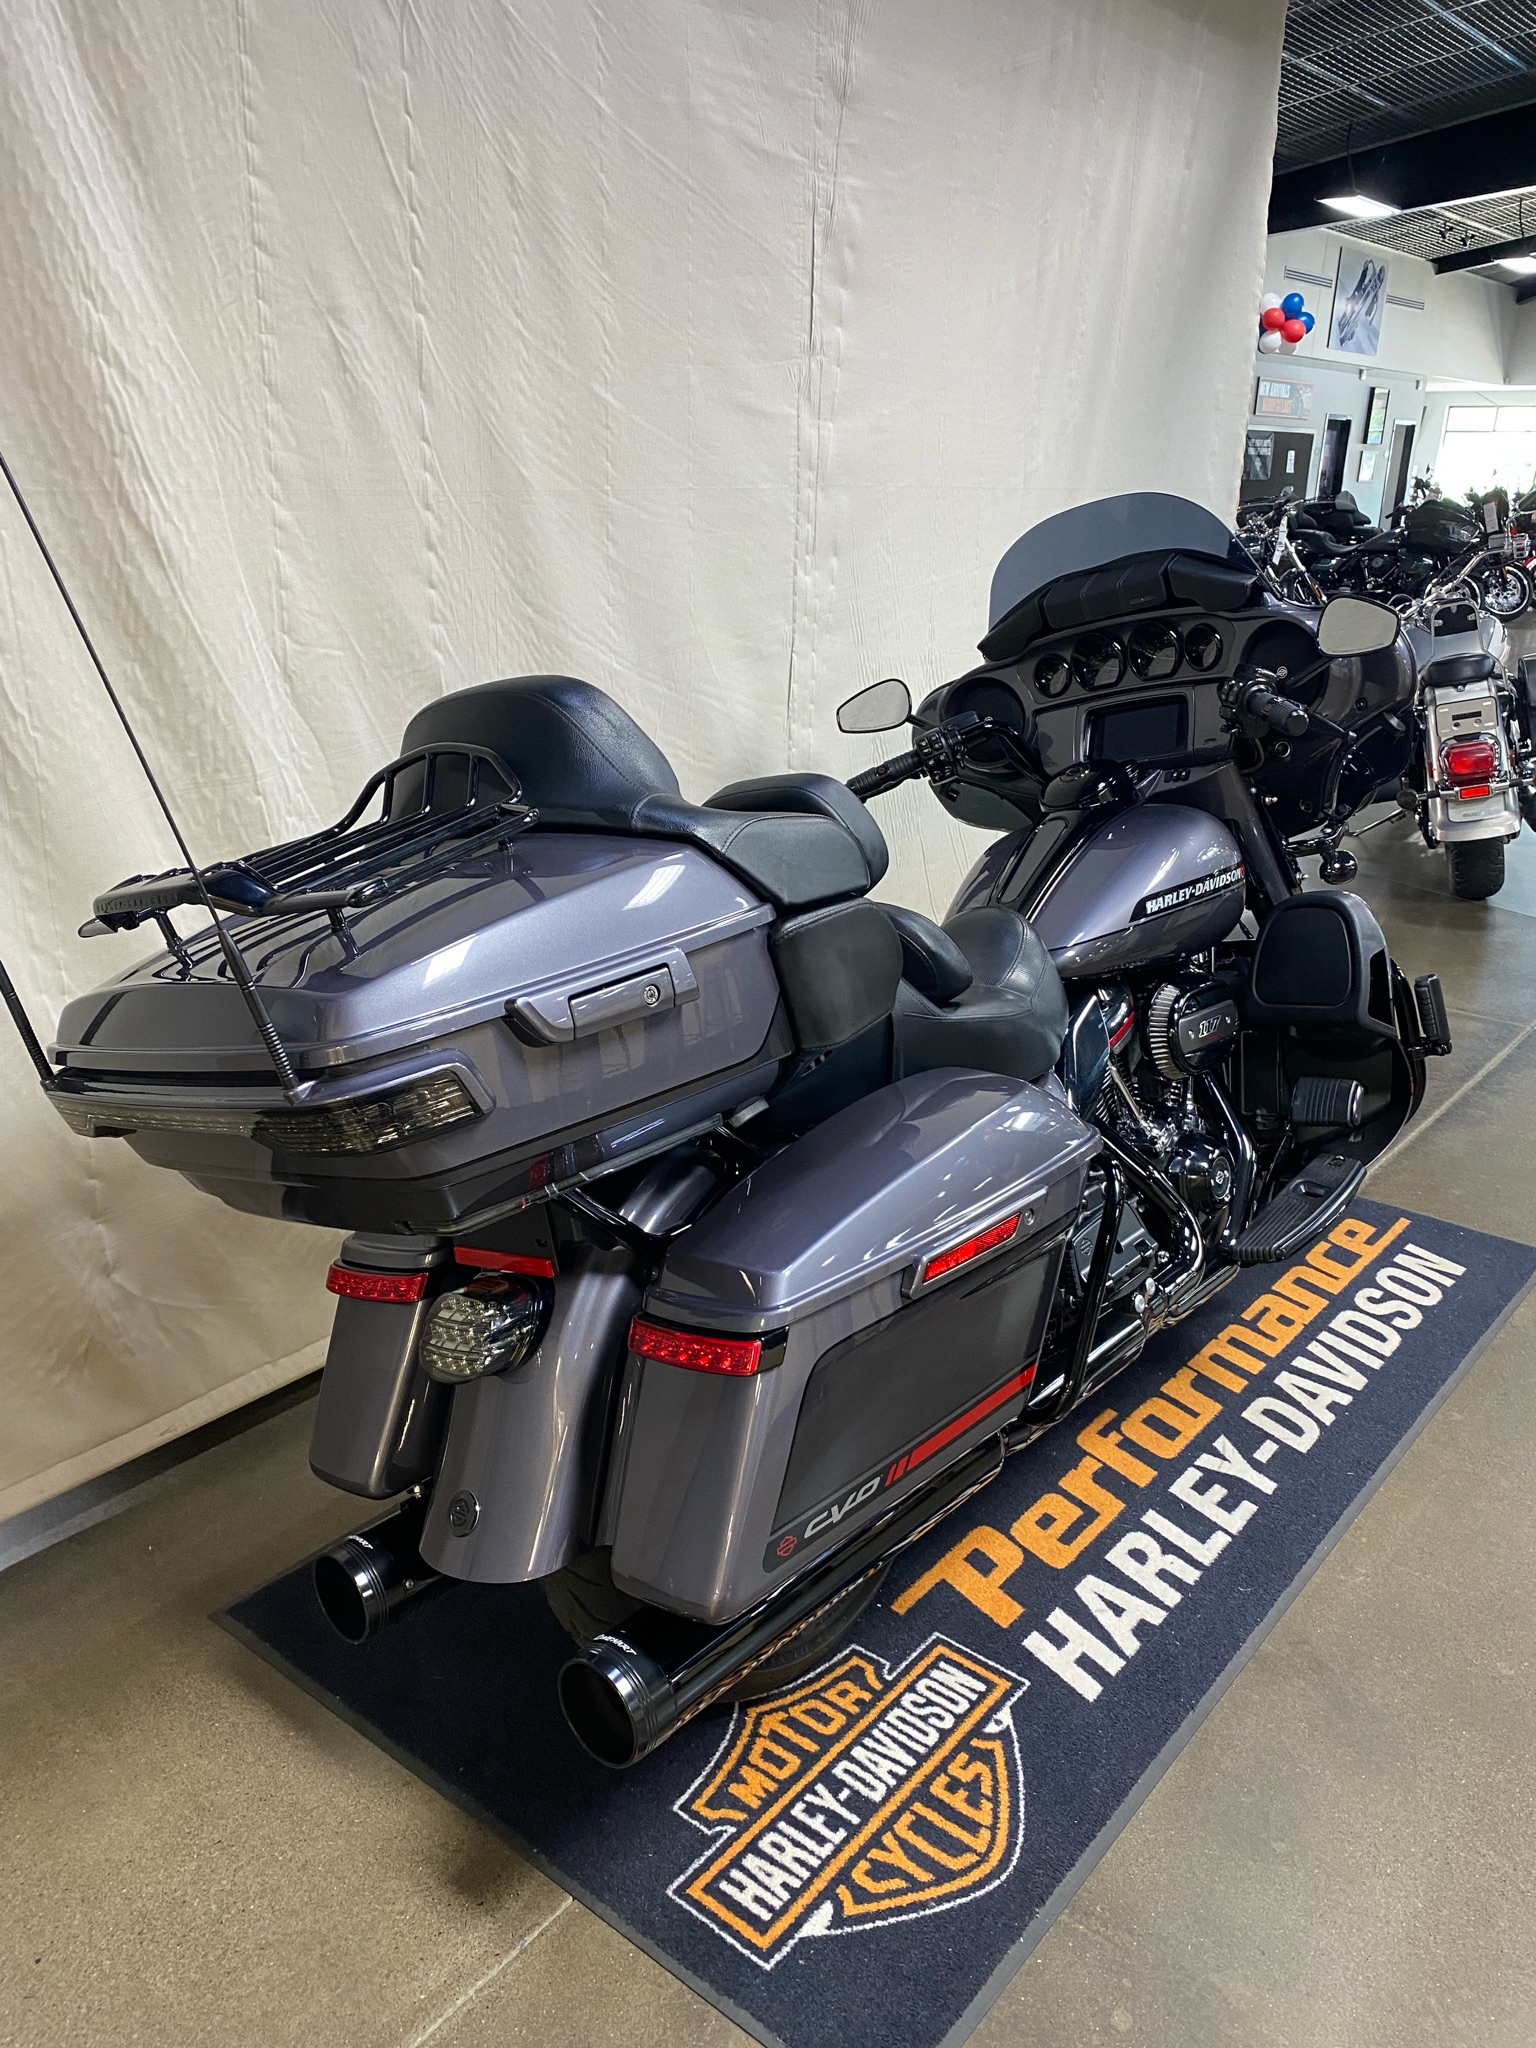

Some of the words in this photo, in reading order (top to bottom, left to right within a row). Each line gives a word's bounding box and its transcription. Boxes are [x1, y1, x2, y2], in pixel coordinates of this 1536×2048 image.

[1145, 867, 1241, 914] HARLEY-DAVIDSON
[1198, 1014, 1222, 1038] 117
[891, 1217, 1411, 1629] Performance
[1022, 1243, 1467, 1703] HARLEY-DAVIDSON
[804, 1476, 881, 1539] CVO
[718, 1661, 988, 1922] HARLEY-DAVIDSON
[728, 1680, 872, 1810] MOTOR
[851, 1751, 995, 1894] CYCLES
